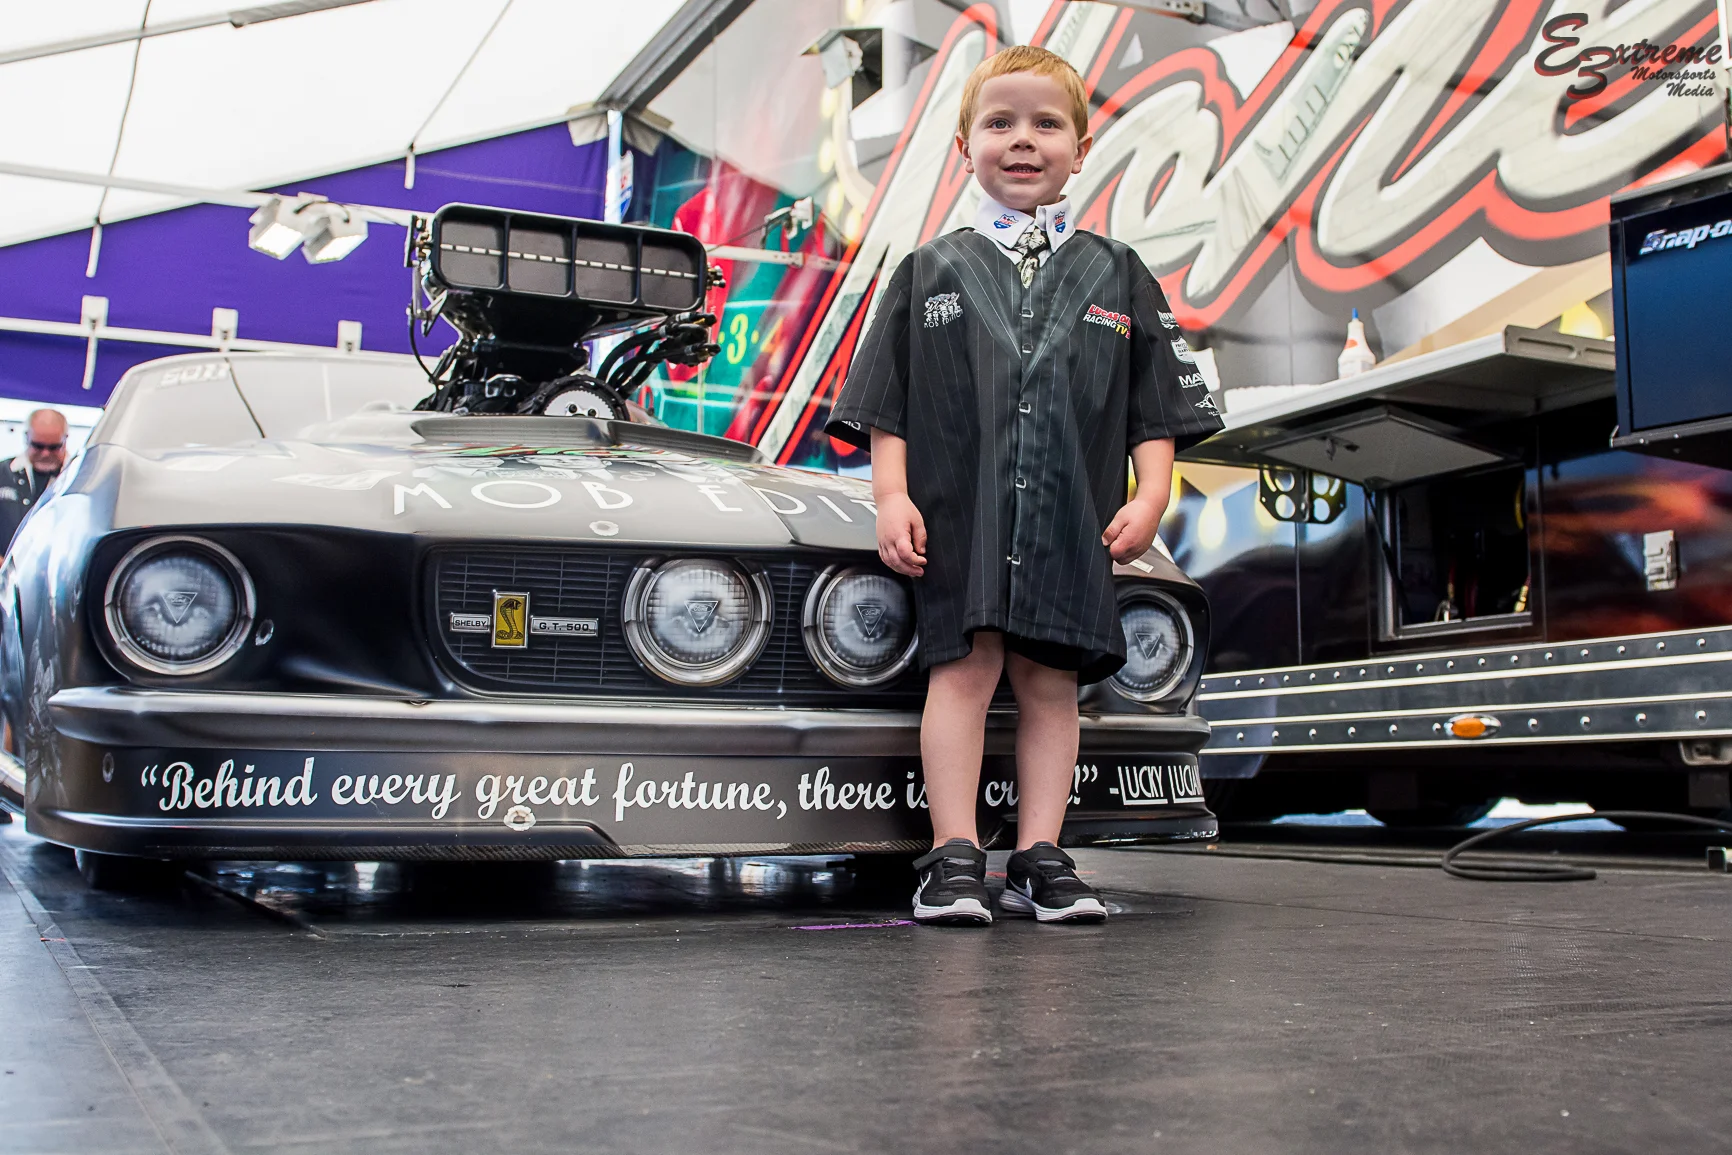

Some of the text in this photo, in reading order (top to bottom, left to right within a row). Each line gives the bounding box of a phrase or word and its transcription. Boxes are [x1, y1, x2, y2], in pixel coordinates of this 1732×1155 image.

[1638, 218, 1732, 255] Snap-o
[1083, 314, 1128, 335] RACING TV
[1087, 304, 1120, 322] LUCAS
[393, 481, 634, 516] MOB
[454, 619, 488, 627] SHELBY
[566, 623, 590, 632] 500
[331, 773, 462, 819] every
[475, 768, 600, 819] great
[611, 762, 788, 822] fortune,
[797, 765, 896, 811] there
